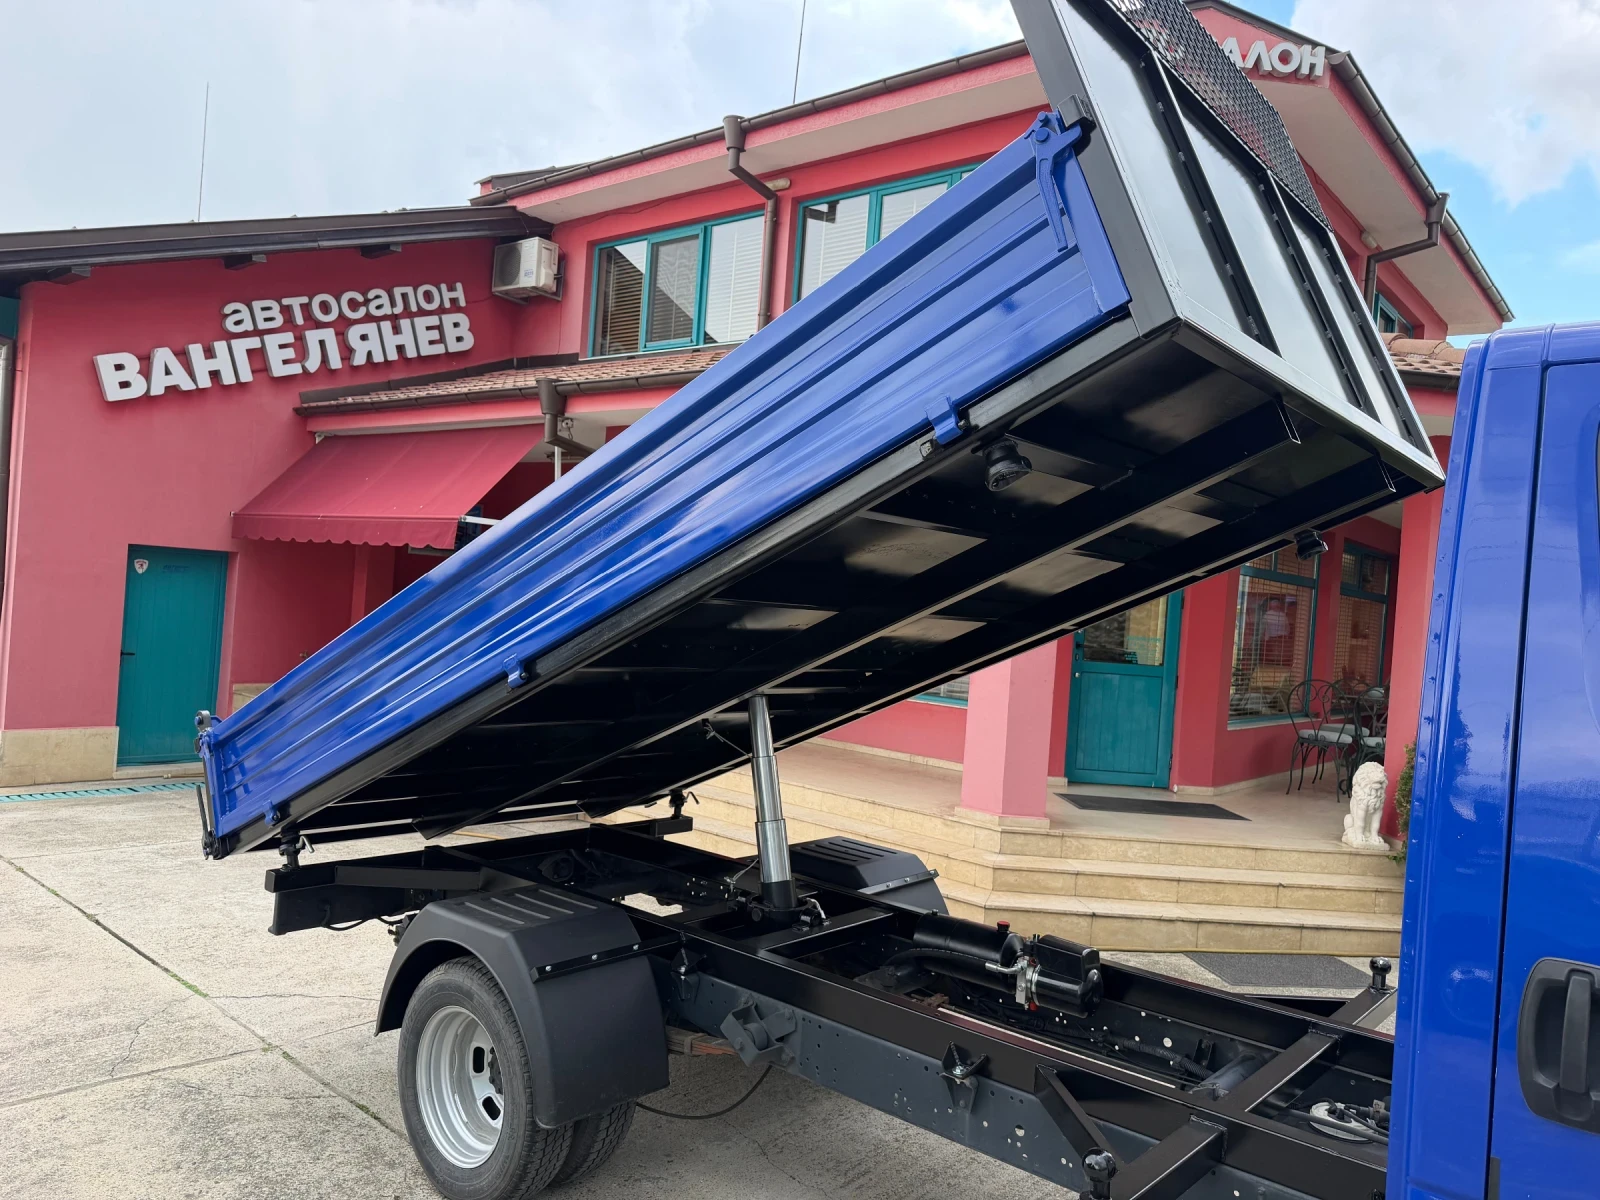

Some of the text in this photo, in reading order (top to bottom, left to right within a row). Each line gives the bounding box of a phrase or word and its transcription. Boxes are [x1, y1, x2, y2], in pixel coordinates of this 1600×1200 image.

[1220, 37, 1326, 79] АЛОН
[222, 282, 467, 334] автосалон
[94, 312, 475, 402] ВАНГЕЛ ЯНЕВ
